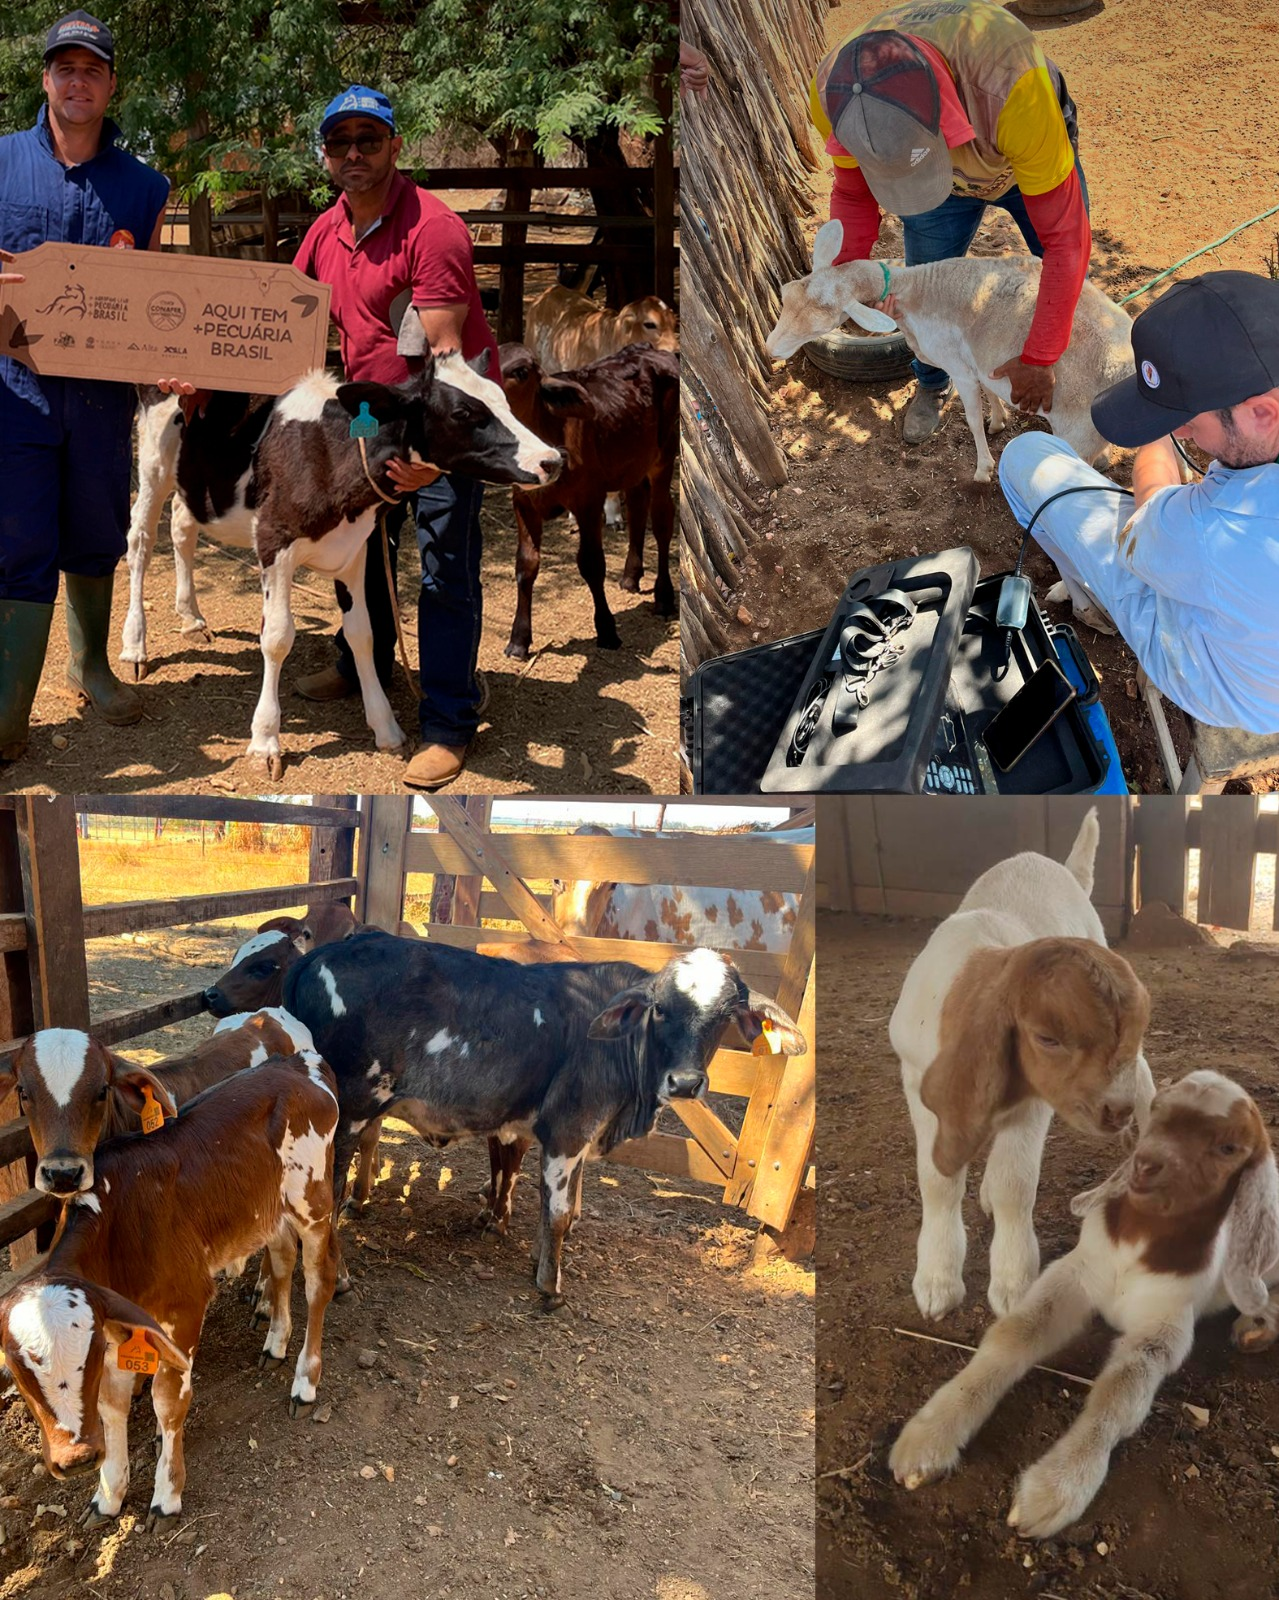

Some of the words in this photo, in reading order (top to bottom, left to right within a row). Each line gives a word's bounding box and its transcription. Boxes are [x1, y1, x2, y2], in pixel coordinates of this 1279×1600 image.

[201, 303, 246, 321] AQUI
[250, 307, 288, 323] TEM
[211, 342, 273, 360] BRASIL
[126, 1360, 149, 1371] 053
